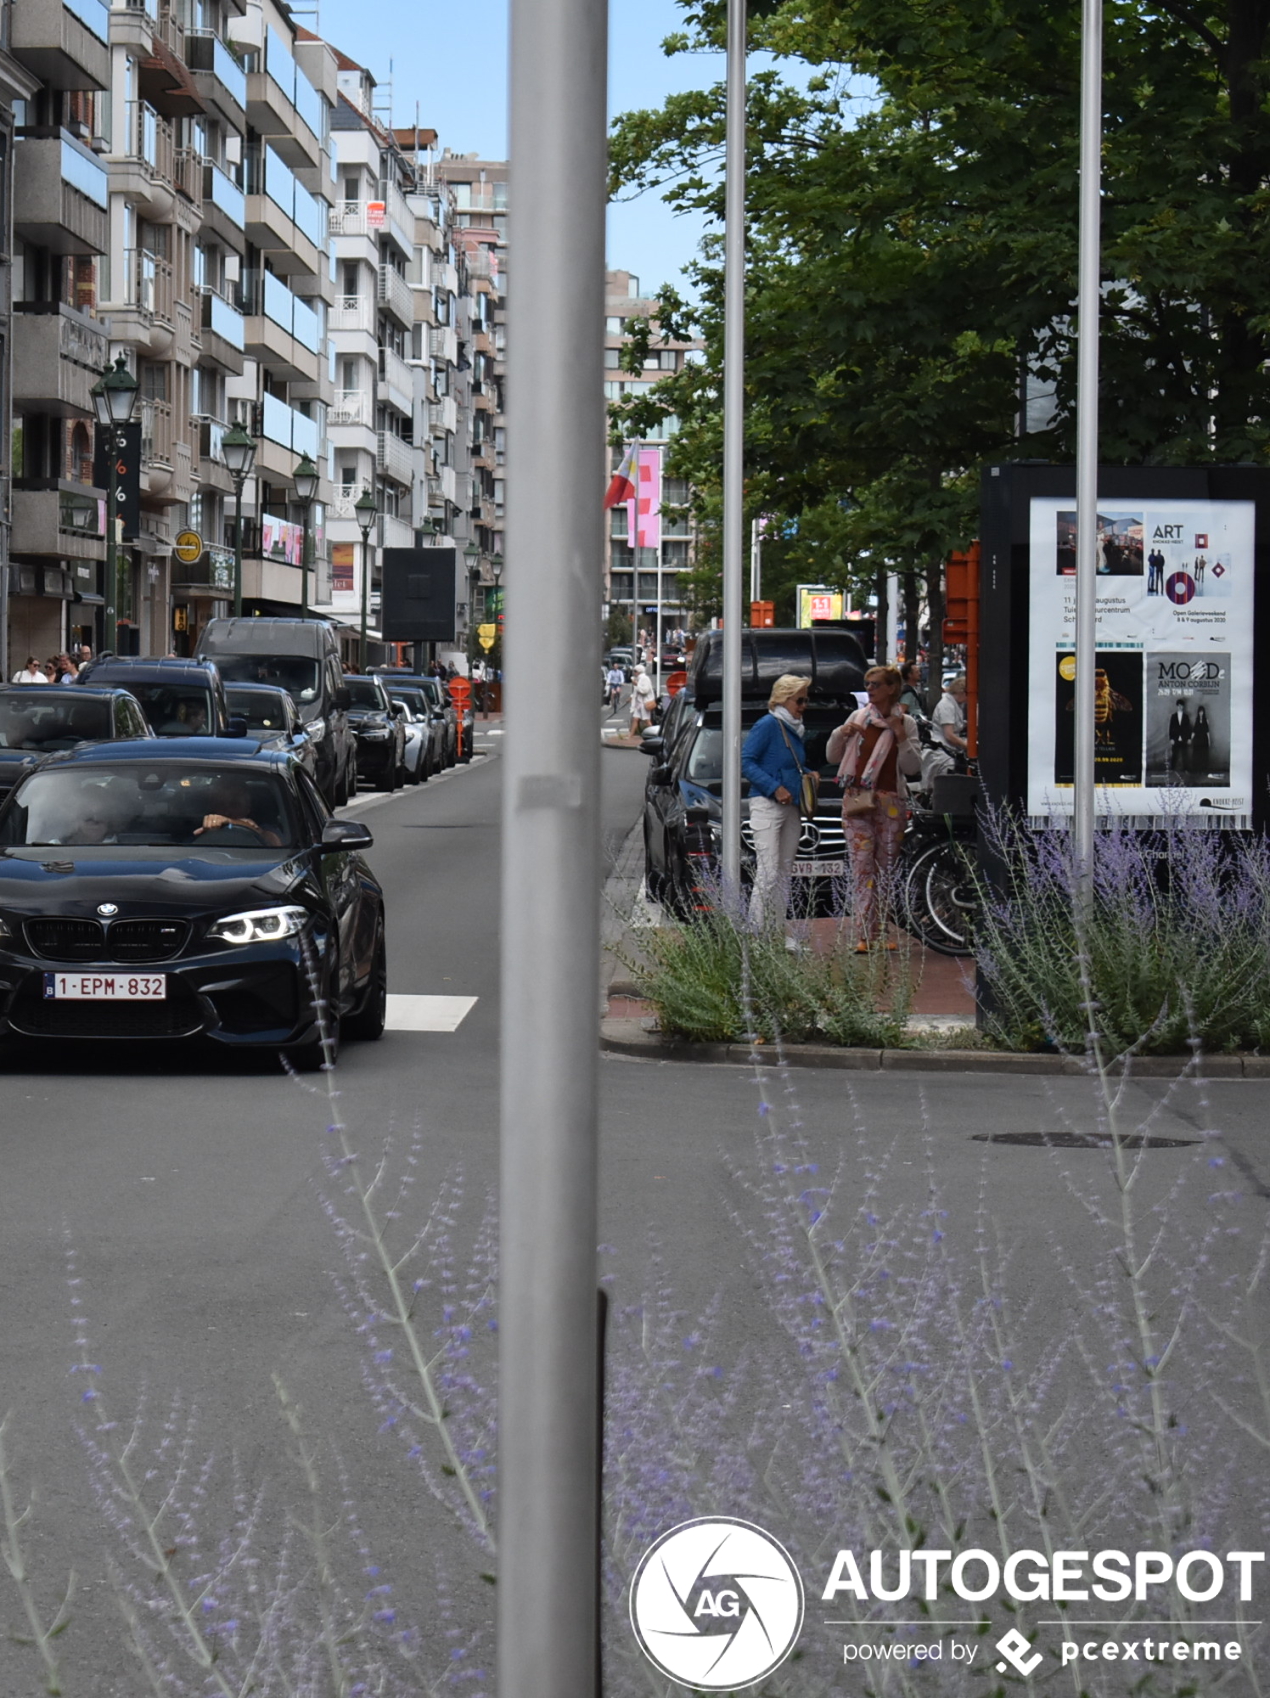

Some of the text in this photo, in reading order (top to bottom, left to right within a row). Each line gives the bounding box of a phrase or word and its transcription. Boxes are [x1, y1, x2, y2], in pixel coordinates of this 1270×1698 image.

[1153, 525, 1184, 538] ART
[46, 986, 53, 995] B
[59, 978, 163, 996] 1-EPM-832
